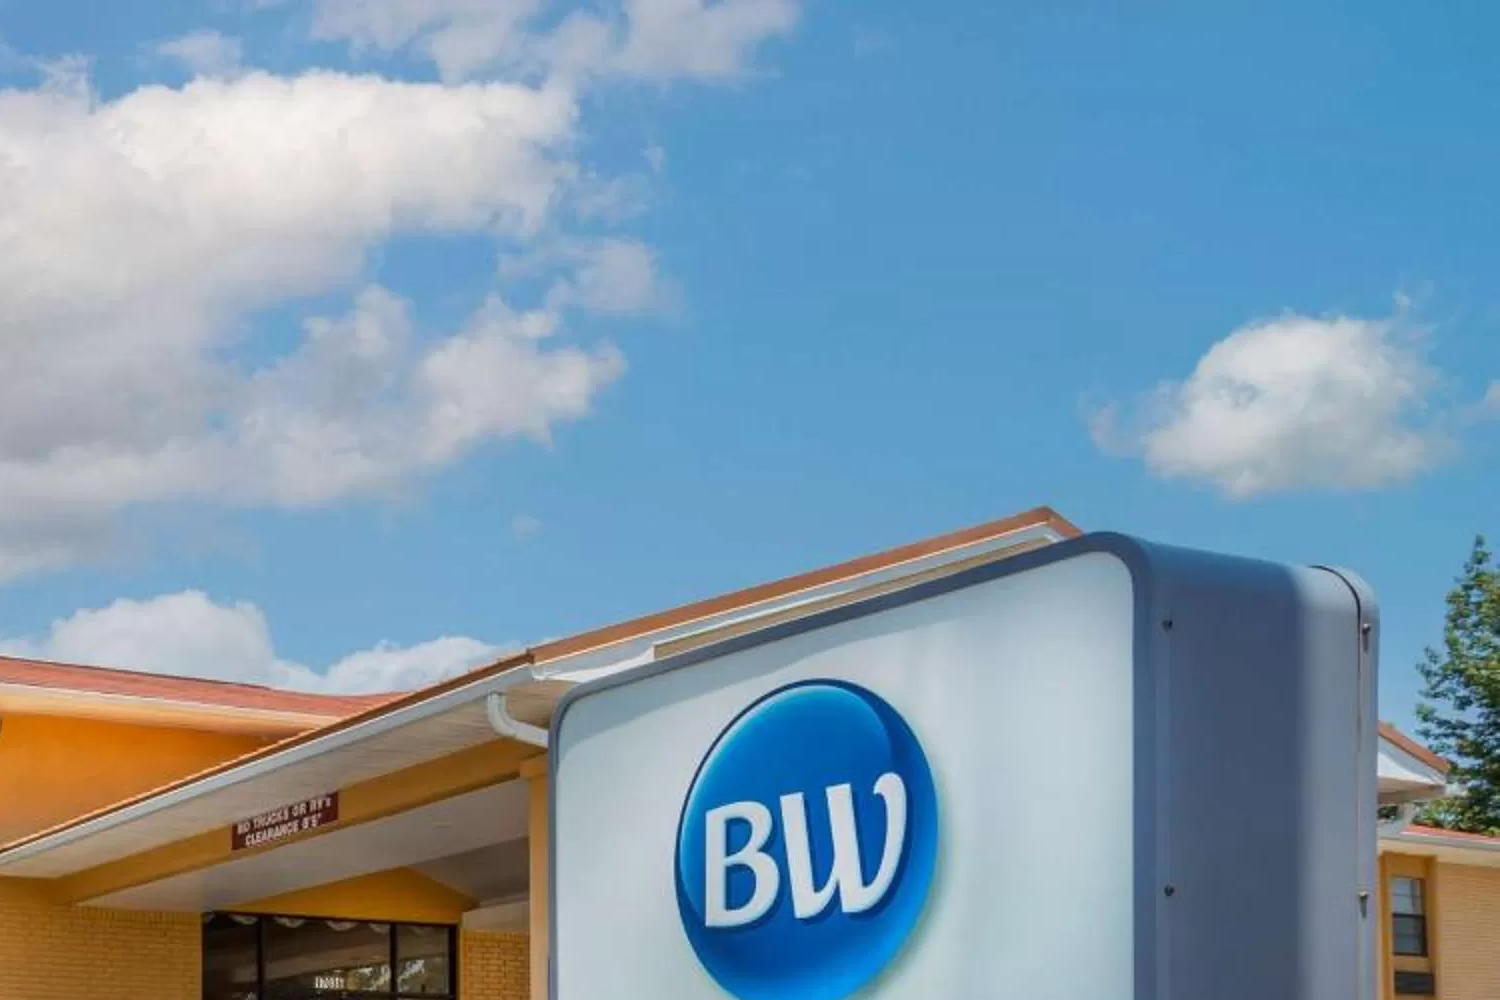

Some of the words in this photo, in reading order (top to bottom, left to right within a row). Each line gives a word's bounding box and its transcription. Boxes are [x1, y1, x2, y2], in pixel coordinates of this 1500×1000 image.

[237, 822, 251, 835] NO
[253, 806, 289, 830] TRUCKS
[291, 802, 307, 817] OR
[245, 818, 299, 847] CLEARANCE
[705, 772, 907, 928] BW
